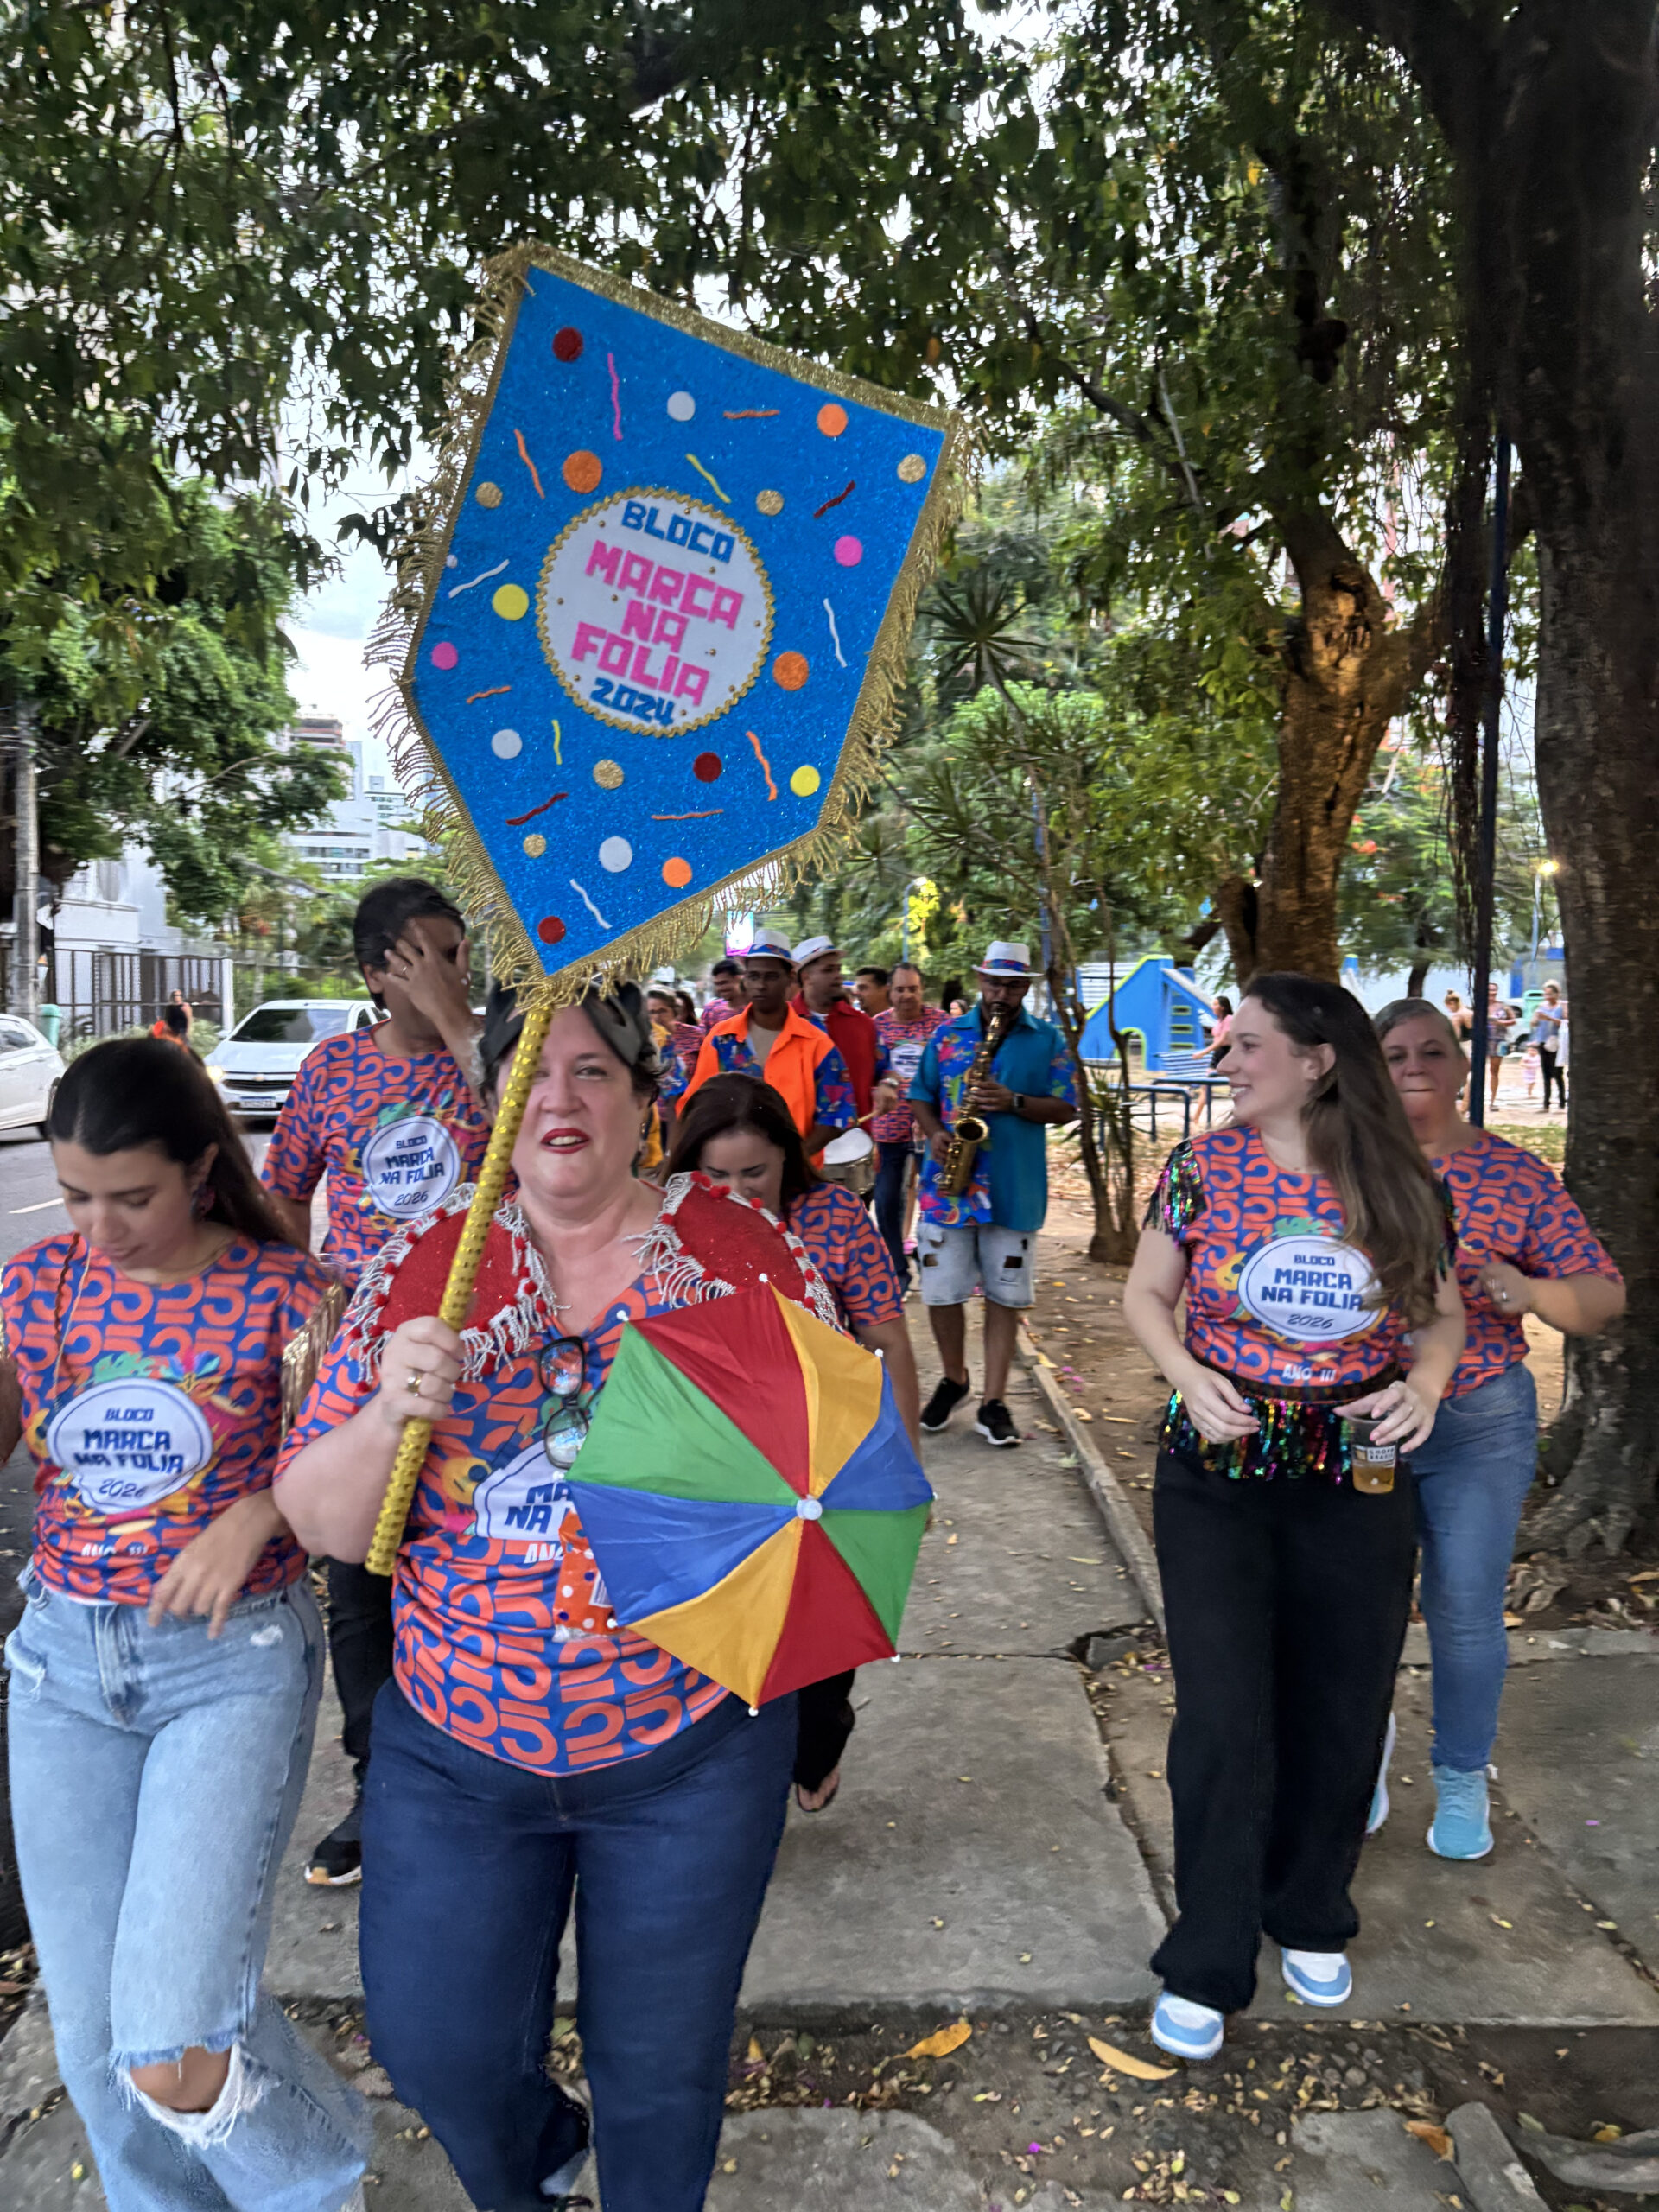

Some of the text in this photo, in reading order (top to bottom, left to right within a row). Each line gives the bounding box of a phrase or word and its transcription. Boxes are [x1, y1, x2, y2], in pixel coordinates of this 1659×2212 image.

[621, 500, 735, 564] BLOCO
[585, 539, 744, 630] MARCA
[620, 599, 690, 654] NA
[571, 621, 709, 707] FOLIA
[589, 677, 676, 726] 2024
[396, 1135, 428, 1149] BLOCO
[385, 1147, 435, 1169] MARCA
[379, 1162, 445, 1185] NA FOLIA
[394, 1191, 429, 1206] 2026
[1294, 1255, 1335, 1266] BLOCO
[1274, 1268, 1352, 1290] MARCA
[1262, 1286, 1363, 1312] NA FOLIA
[1287, 1314, 1335, 1329] 2026
[1281, 1363, 1313, 1381] ANO
[105, 1408, 154, 1421] BLOCO
[84, 1429, 171, 1450] MARCA
[116, 1454, 184, 1474] FOLIA
[99, 1478, 146, 1497] 2026
[504, 1505, 553, 1534] NA
